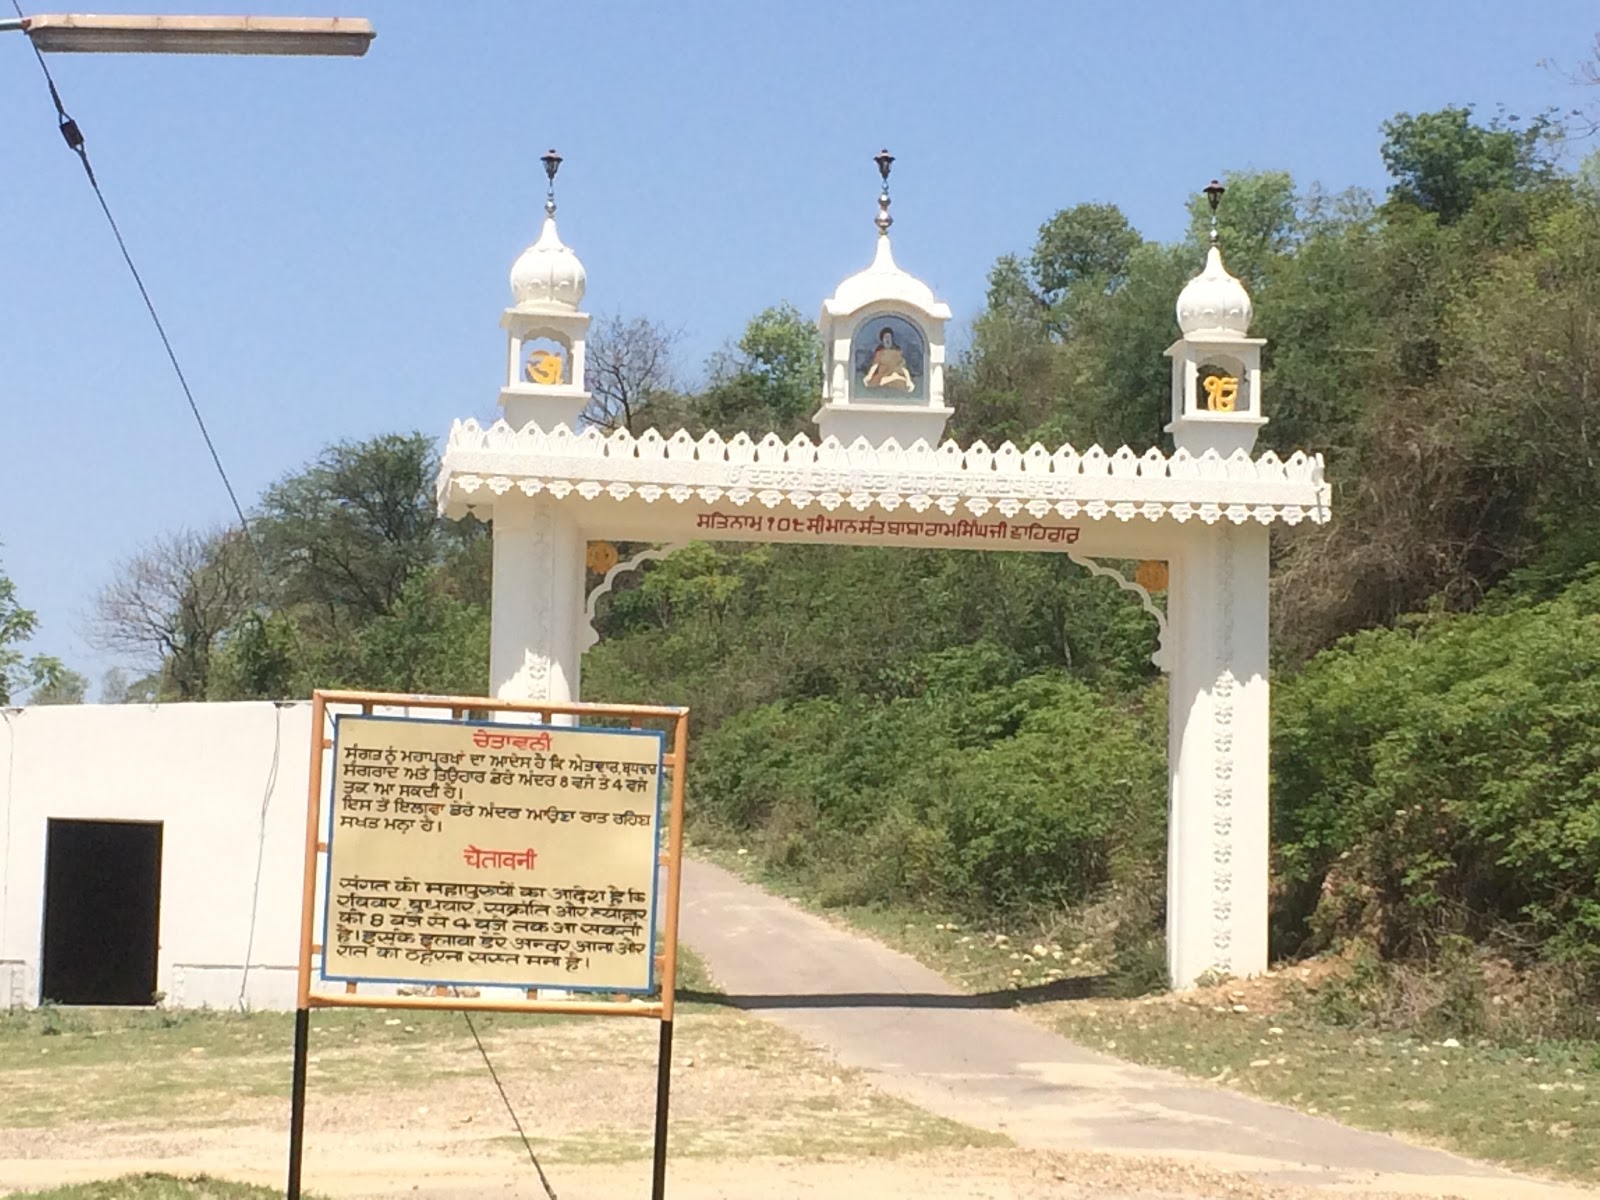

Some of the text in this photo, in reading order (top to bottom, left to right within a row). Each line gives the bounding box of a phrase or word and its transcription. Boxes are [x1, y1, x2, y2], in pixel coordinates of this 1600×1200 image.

[767, 517, 804, 532] ੧੦੮
[473, 730, 552, 751] ਚੇਤਾਵਨੀ
[344, 743, 383, 760] ਸੰਗਤ
[470, 754, 485, 766] ਦਾ
[534, 753, 546, 769] ਹੈ
[549, 754, 565, 770] ਕਿ
[373, 783, 395, 796] ਆ
[399, 782, 440, 798] ਸਕਦੀ
[404, 765, 430, 780] ਅਤੇ
[490, 768, 515, 785] ਡੇਰੇ
[518, 770, 557, 787] ਅੰਦਰ
[560, 776, 568, 788] 8
[571, 774, 596, 789] ਵਜੇ
[612, 779, 623, 791] 4
[625, 777, 648, 792] ਵਜੇ
[342, 794, 373, 811] ਇਸ
[449, 800, 475, 816] ਡੇਰੇ
[478, 802, 522, 818] ਅੰਦਰ
[579, 811, 610, 824] ਰਾਤ
[340, 815, 381, 829] ਸਖਤ
[464, 845, 537, 870] चेतावनी
[339, 874, 391, 891] संगत
[394, 876, 420, 893] को
[519, 886, 547, 898] का
[549, 885, 606, 904] आदेश
[607, 885, 625, 905] है
[628, 887, 646, 903] कि
[339, 908, 367, 924] को
[370, 913, 384, 927] 8
[389, 911, 423, 927] बजे
[427, 912, 450, 928] से
[452, 917, 471, 929] 4
[474, 914, 508, 932] बजे
[512, 920, 549, 932] तक
[551, 921, 578, 934] आ
[552, 901, 589, 918] और
[419, 932, 476, 949] इलावा
[510, 937, 570, 953] अन्दर
[572, 940, 615, 954] आना
[615, 937, 647, 955] और
[337, 945, 368, 957] रात
[524, 954, 562, 967] मना
